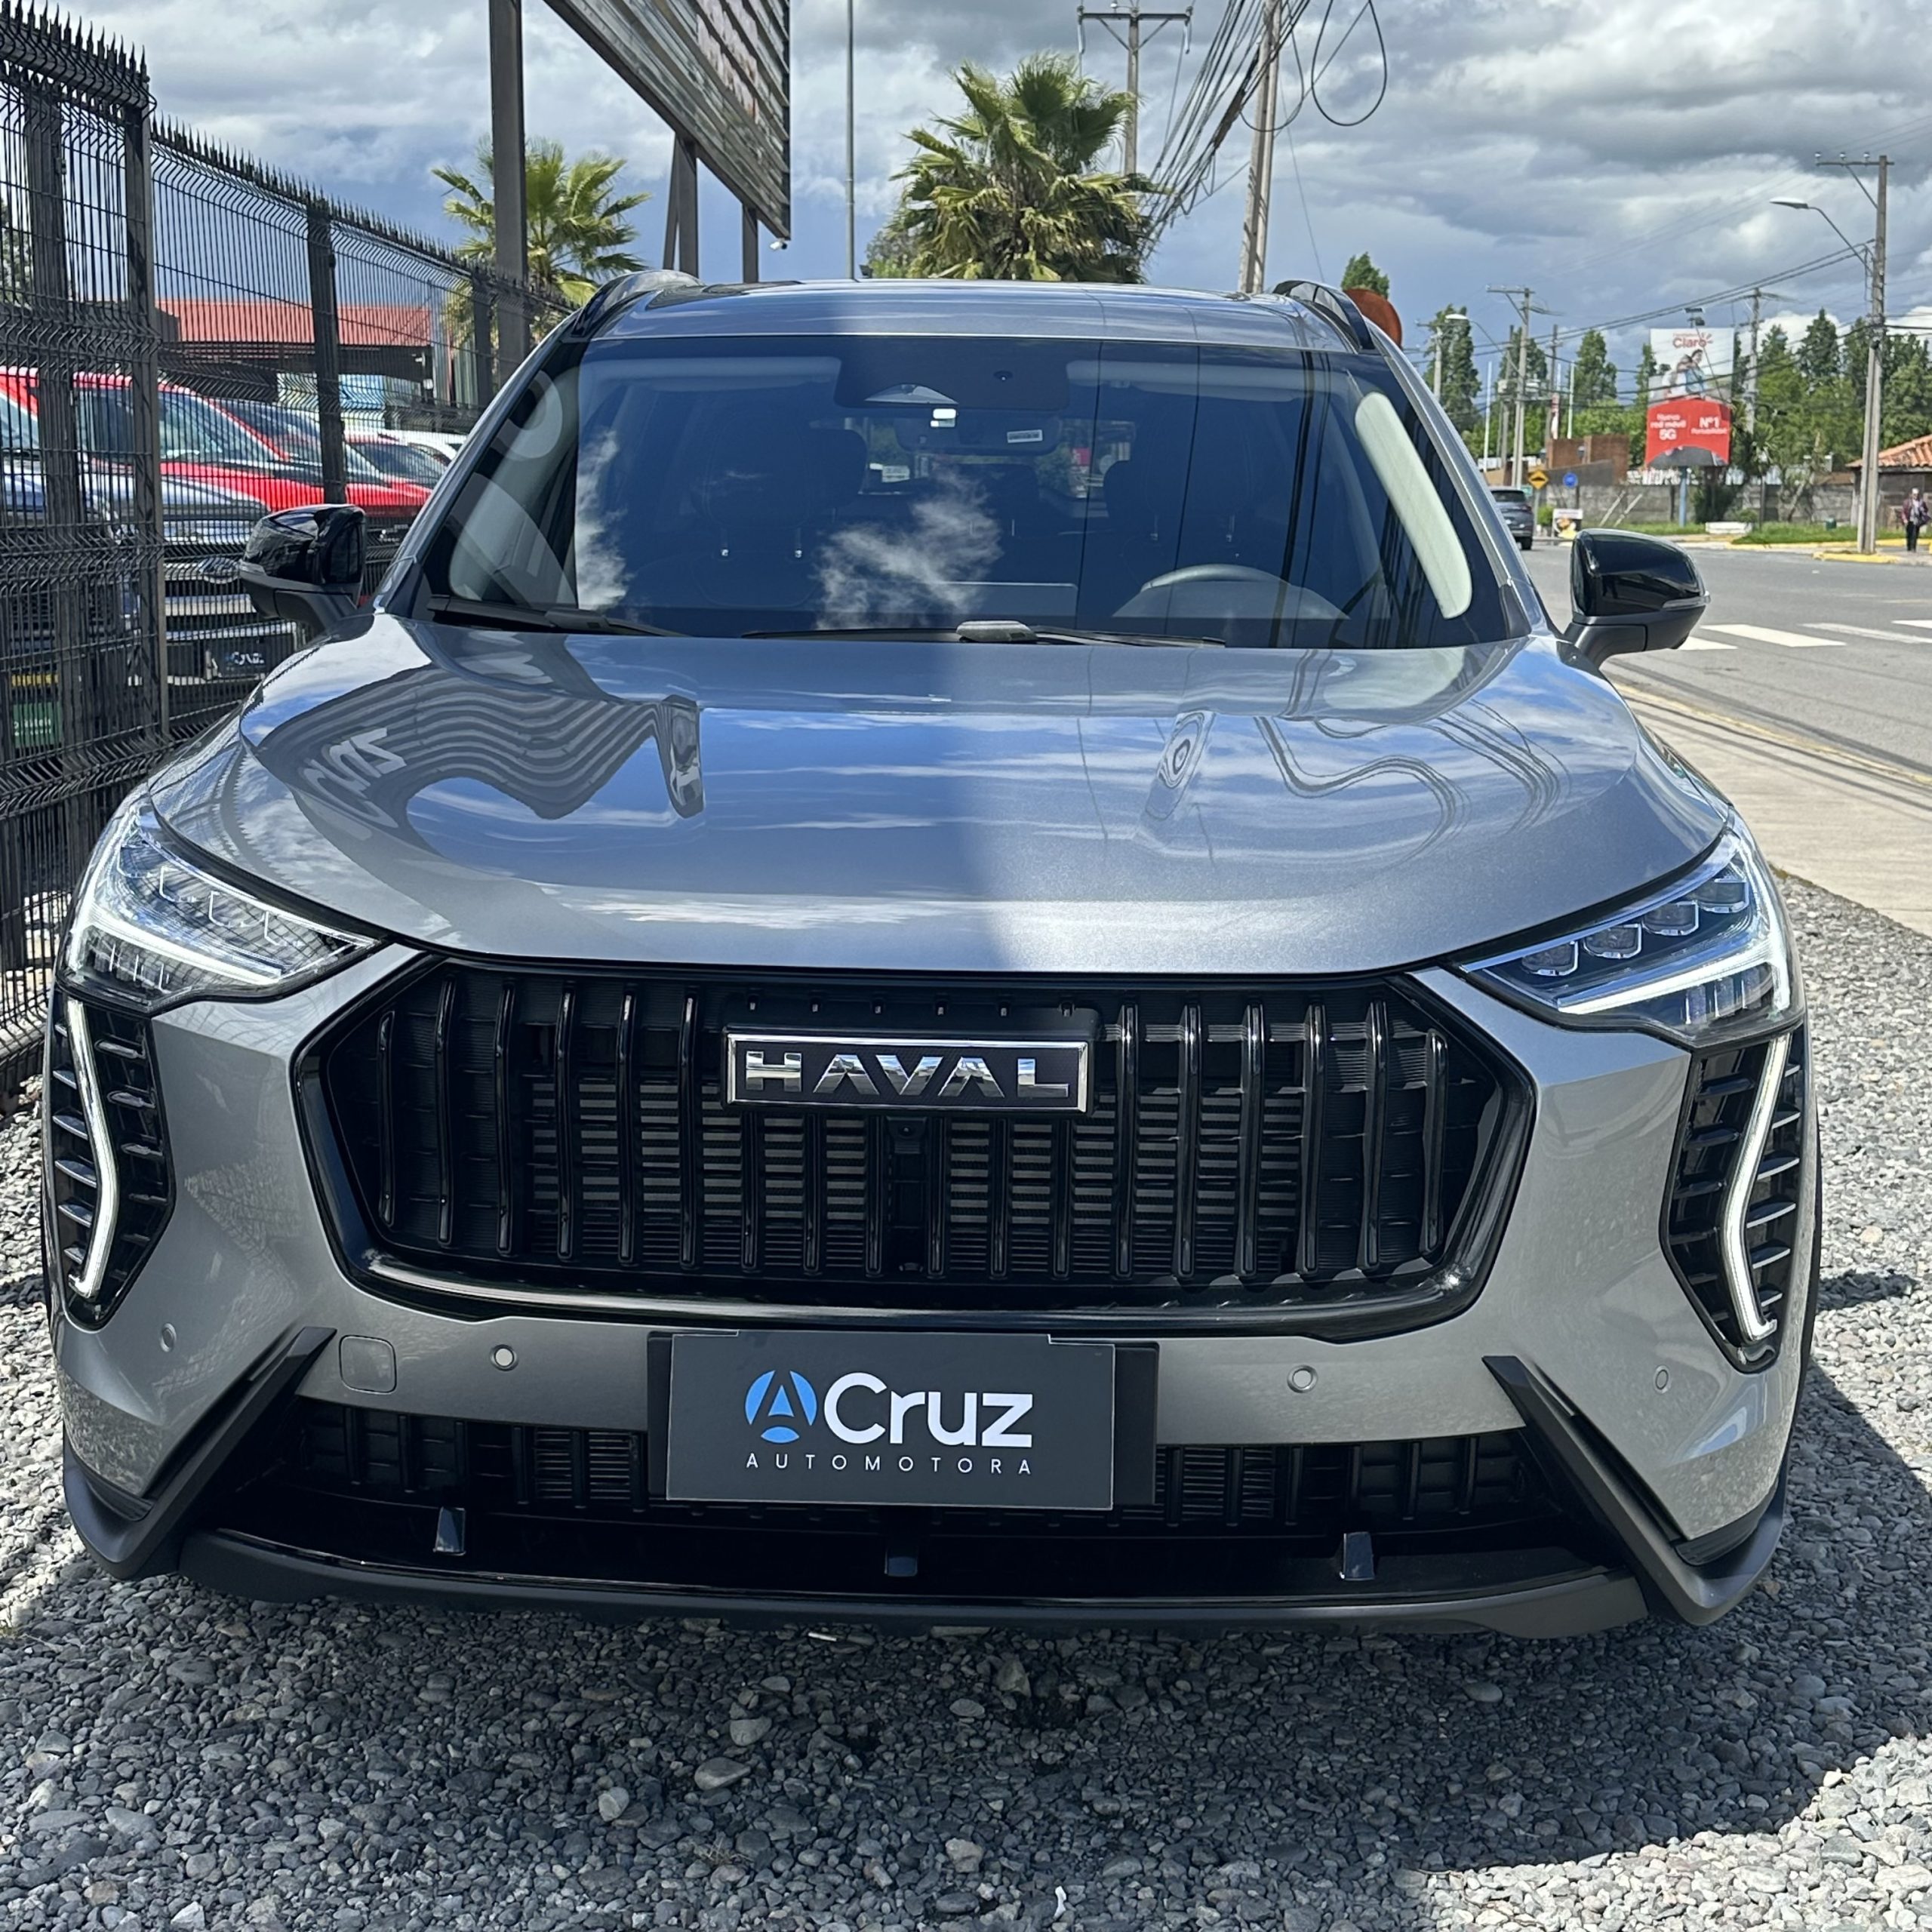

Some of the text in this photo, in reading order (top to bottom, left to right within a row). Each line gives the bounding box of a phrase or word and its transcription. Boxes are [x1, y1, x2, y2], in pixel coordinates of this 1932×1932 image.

[1672, 337, 1707, 349] Claro
[1659, 428, 1677, 441] 5G
[744, 1050, 1069, 1099] HAVAL
[746, 1452, 1031, 1475] AUTOMOTORA
